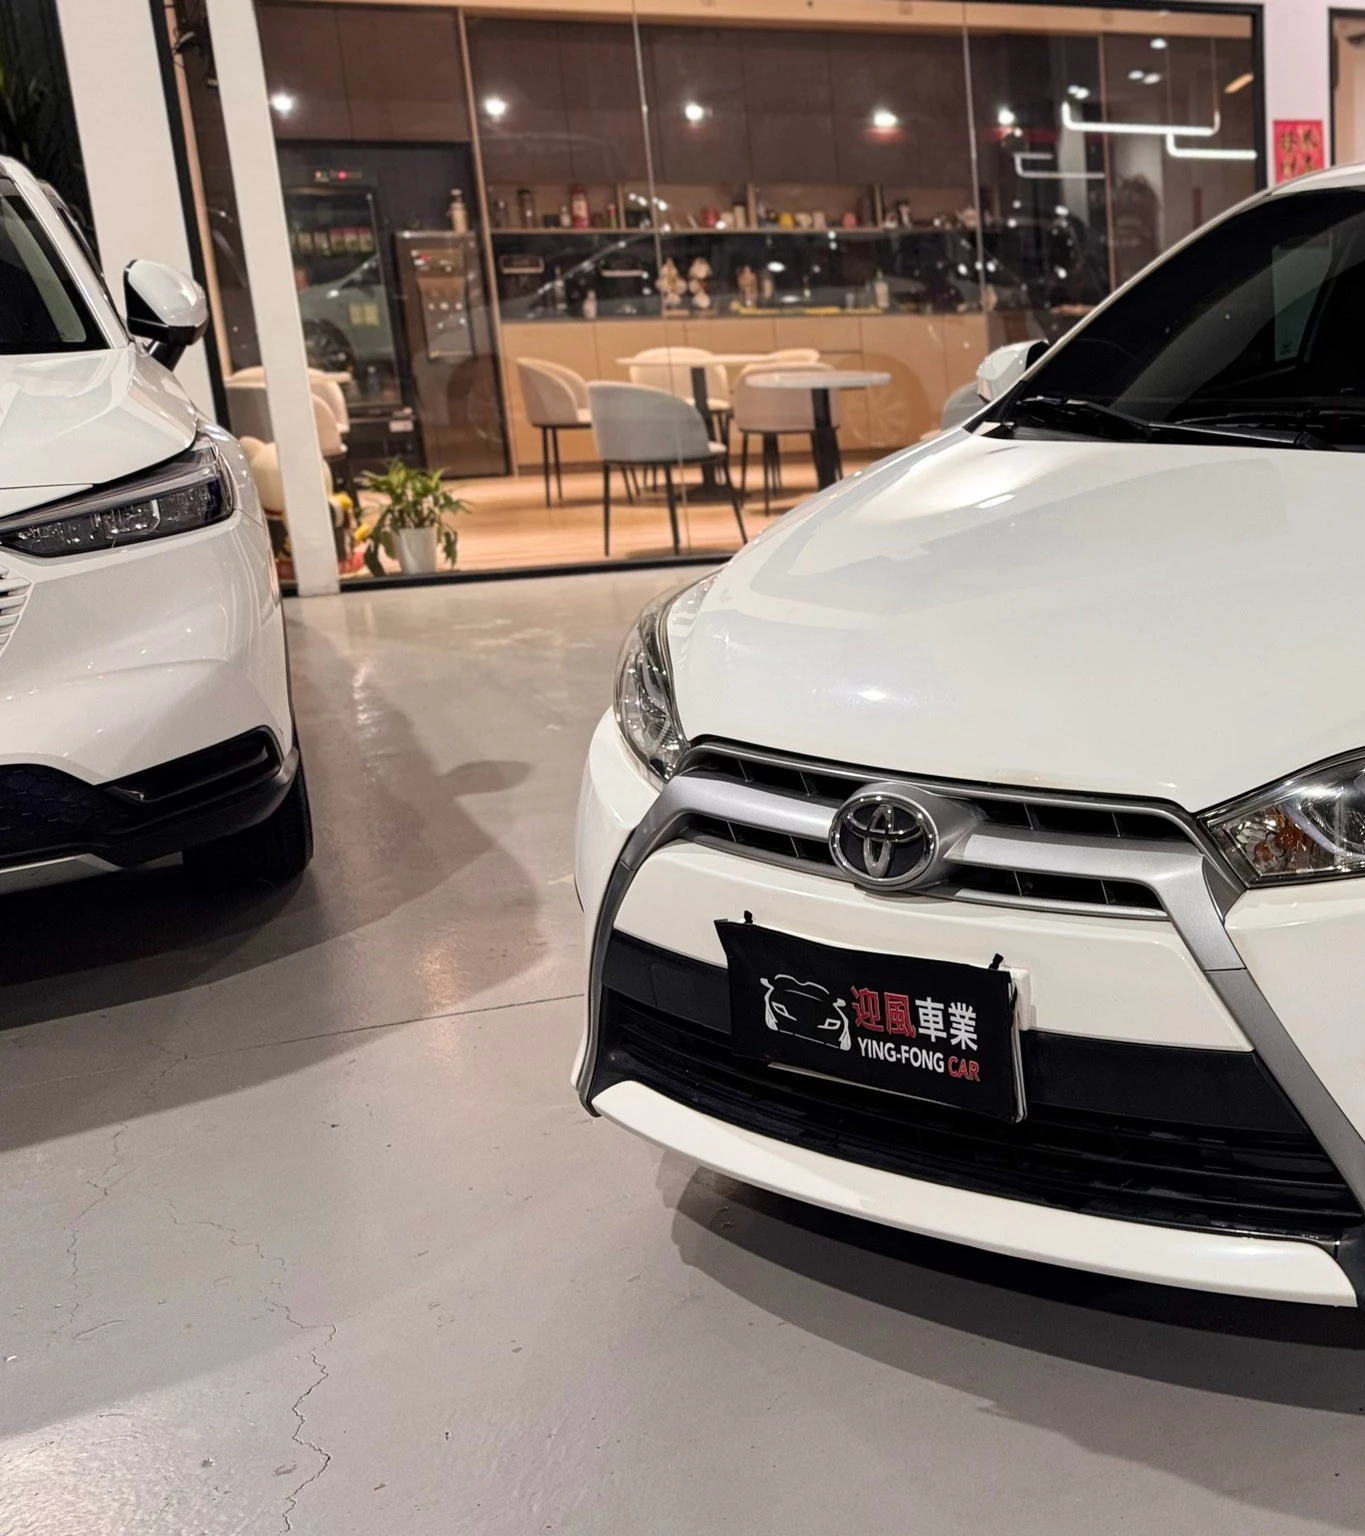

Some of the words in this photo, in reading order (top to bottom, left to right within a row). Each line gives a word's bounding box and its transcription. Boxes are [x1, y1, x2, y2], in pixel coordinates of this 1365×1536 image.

[850, 985, 979, 1051] 迎風車業
[856, 1036, 945, 1074] YING-FONG
[947, 1055, 981, 1083] CAR
